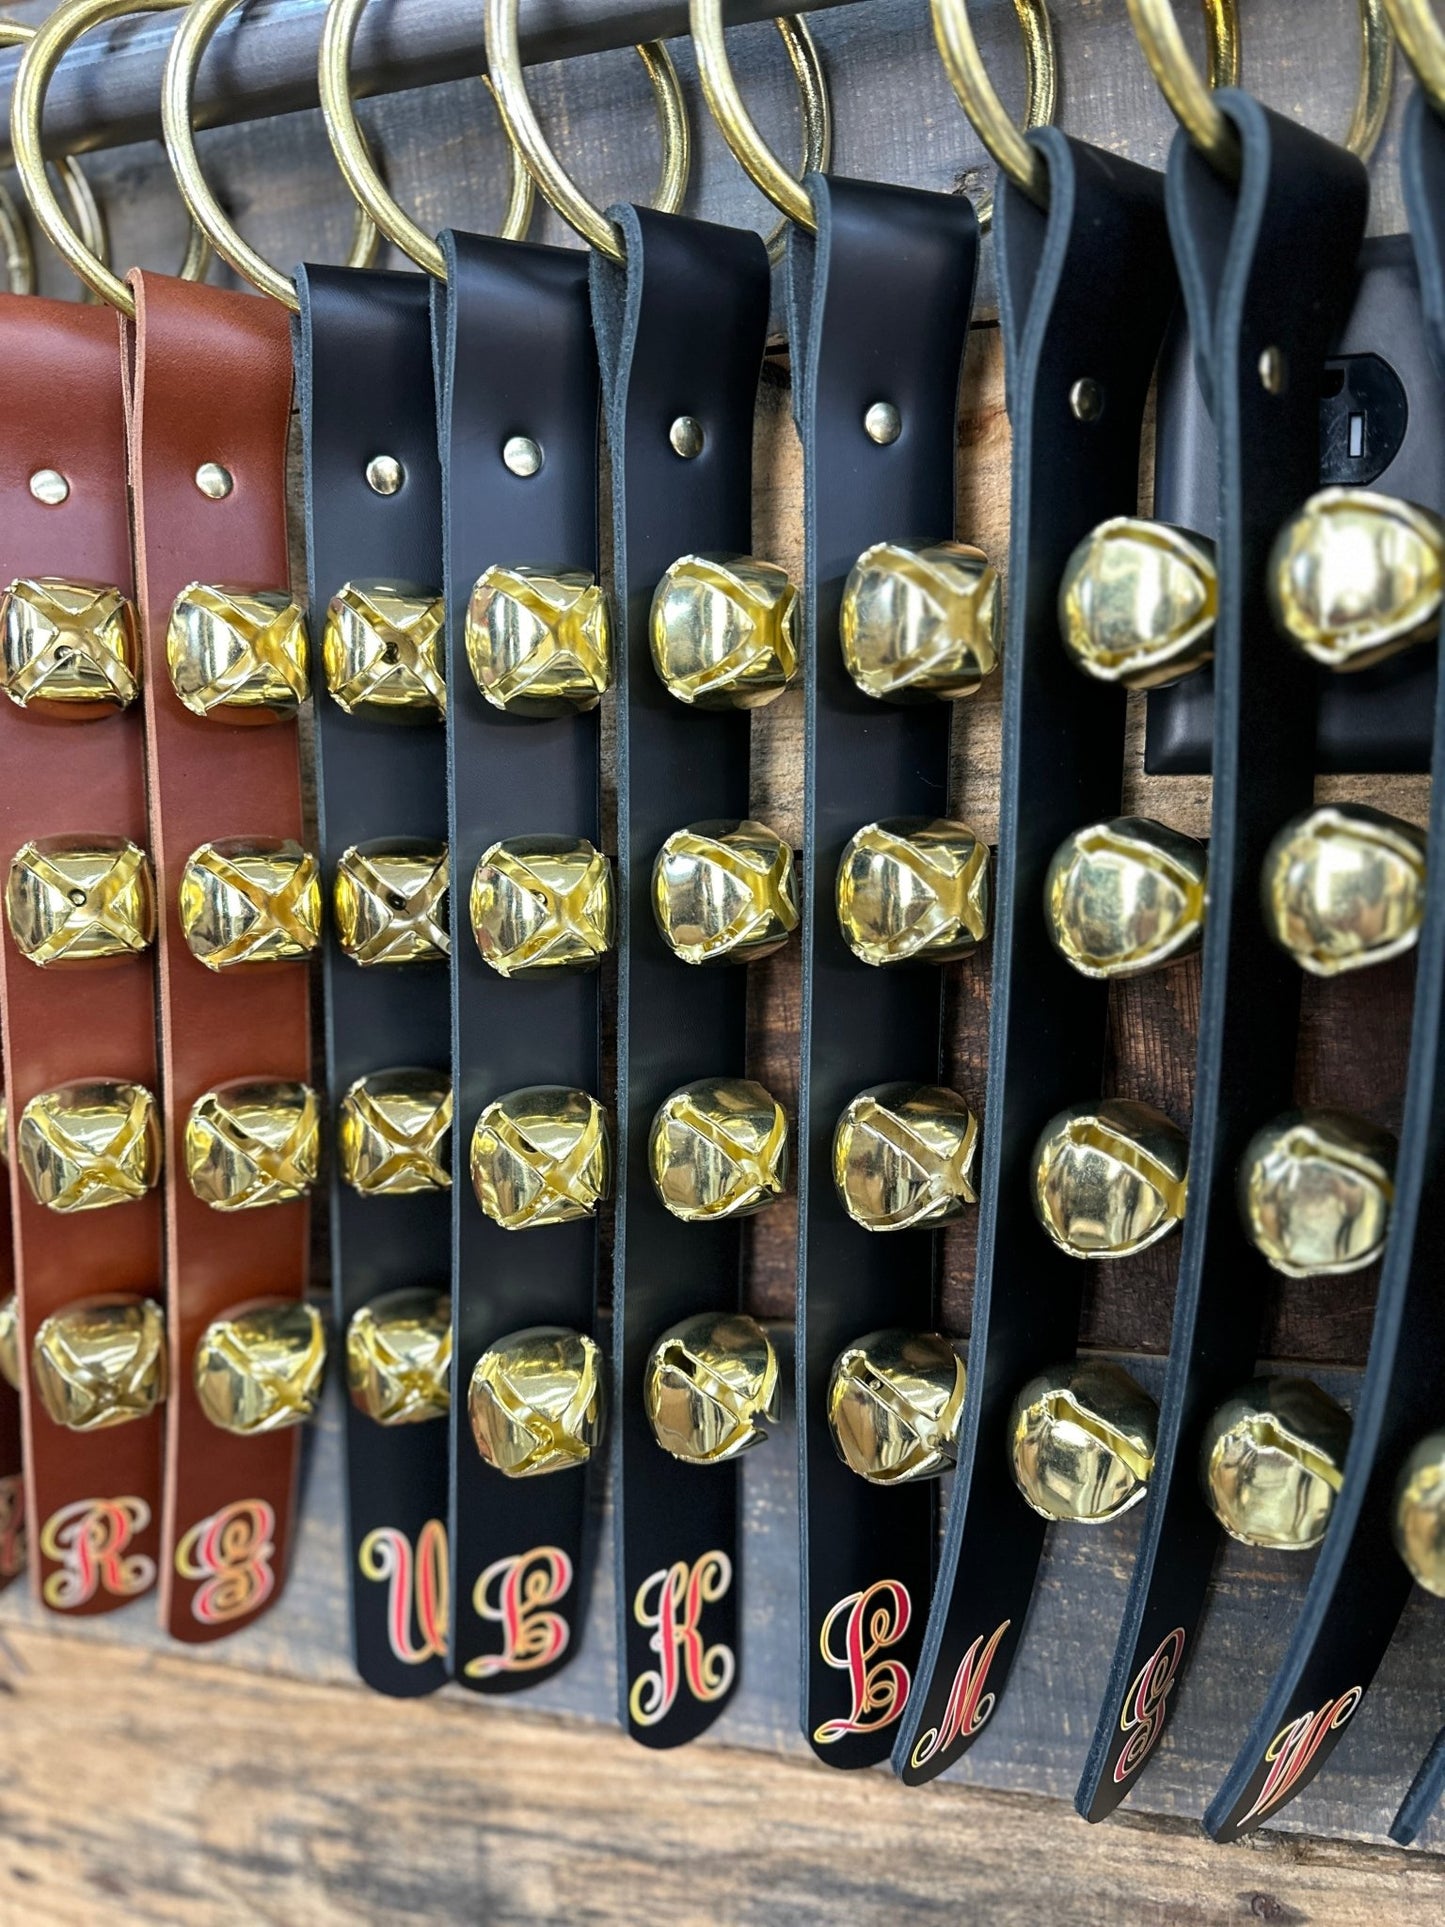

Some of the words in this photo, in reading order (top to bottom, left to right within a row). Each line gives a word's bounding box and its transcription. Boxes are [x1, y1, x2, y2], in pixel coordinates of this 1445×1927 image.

[41, 1496, 156, 1608] R
[464, 1545, 573, 1678] L
[629, 1549, 735, 1726] K
[813, 1579, 911, 1744] L
[911, 1618, 1011, 1768] M
